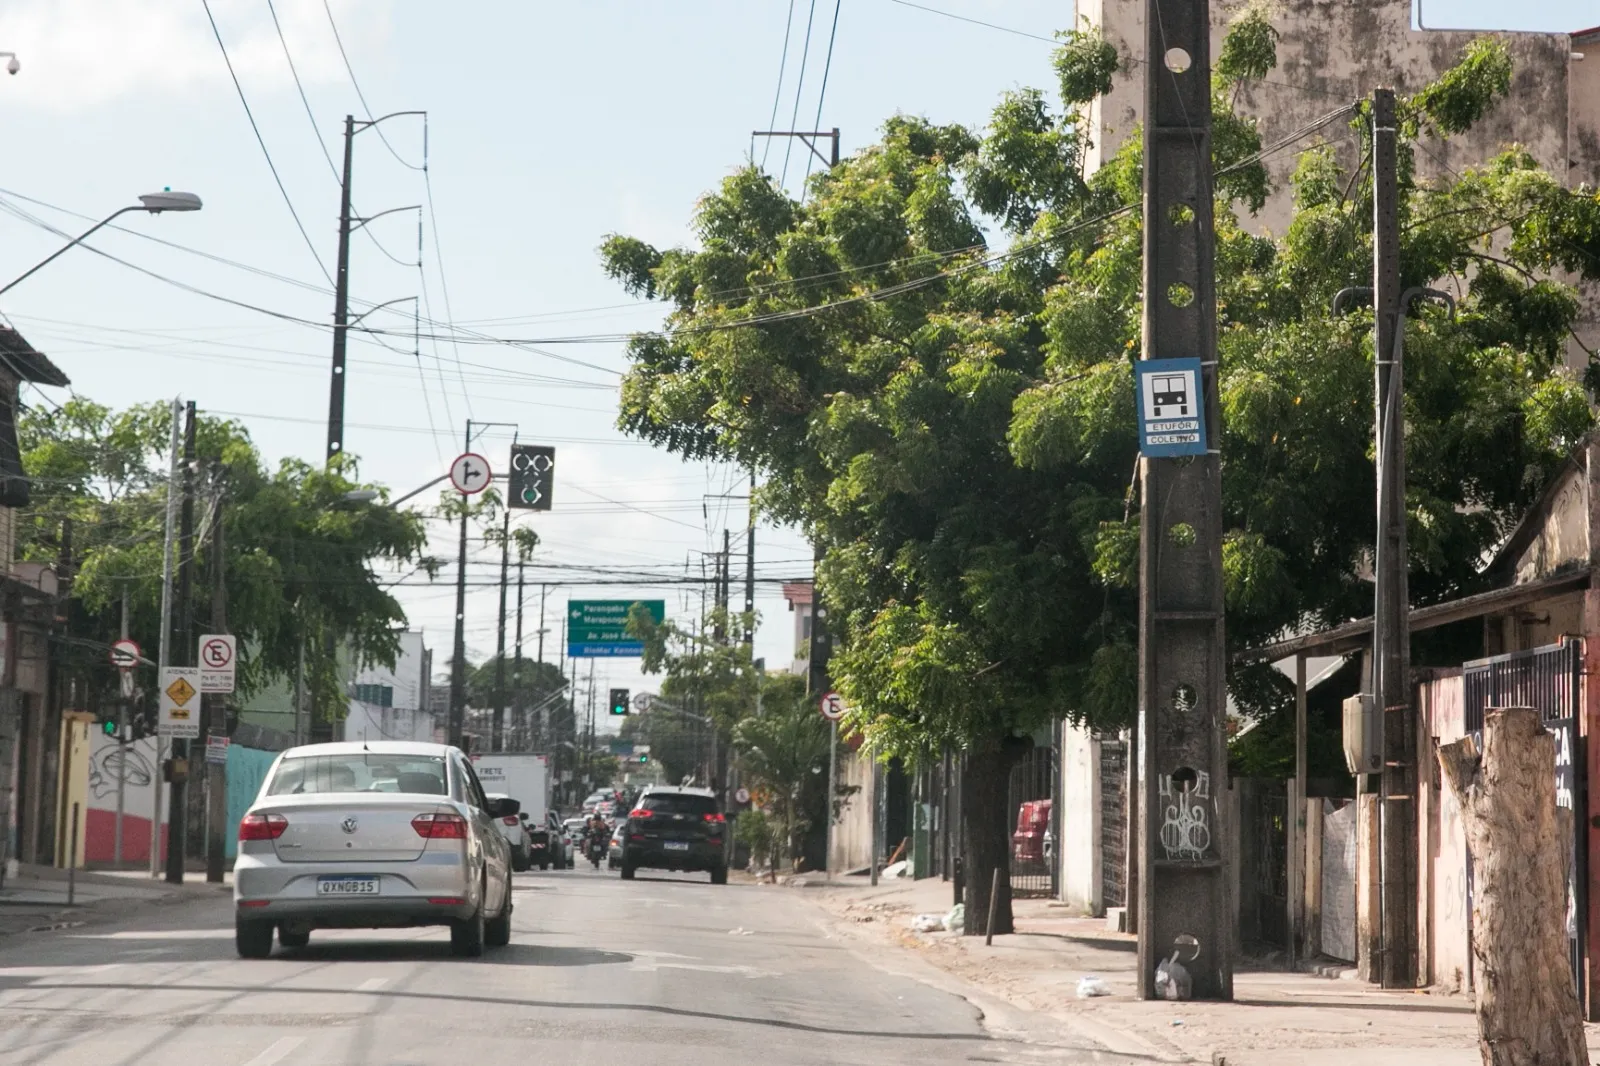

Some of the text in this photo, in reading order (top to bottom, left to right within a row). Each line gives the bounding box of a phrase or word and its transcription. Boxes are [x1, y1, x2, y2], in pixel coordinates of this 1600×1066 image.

[1152, 422, 1192, 431] ETUFOR
[1151, 434, 1196, 444] COLETIVO
[584, 605, 625, 614] Parangaba
